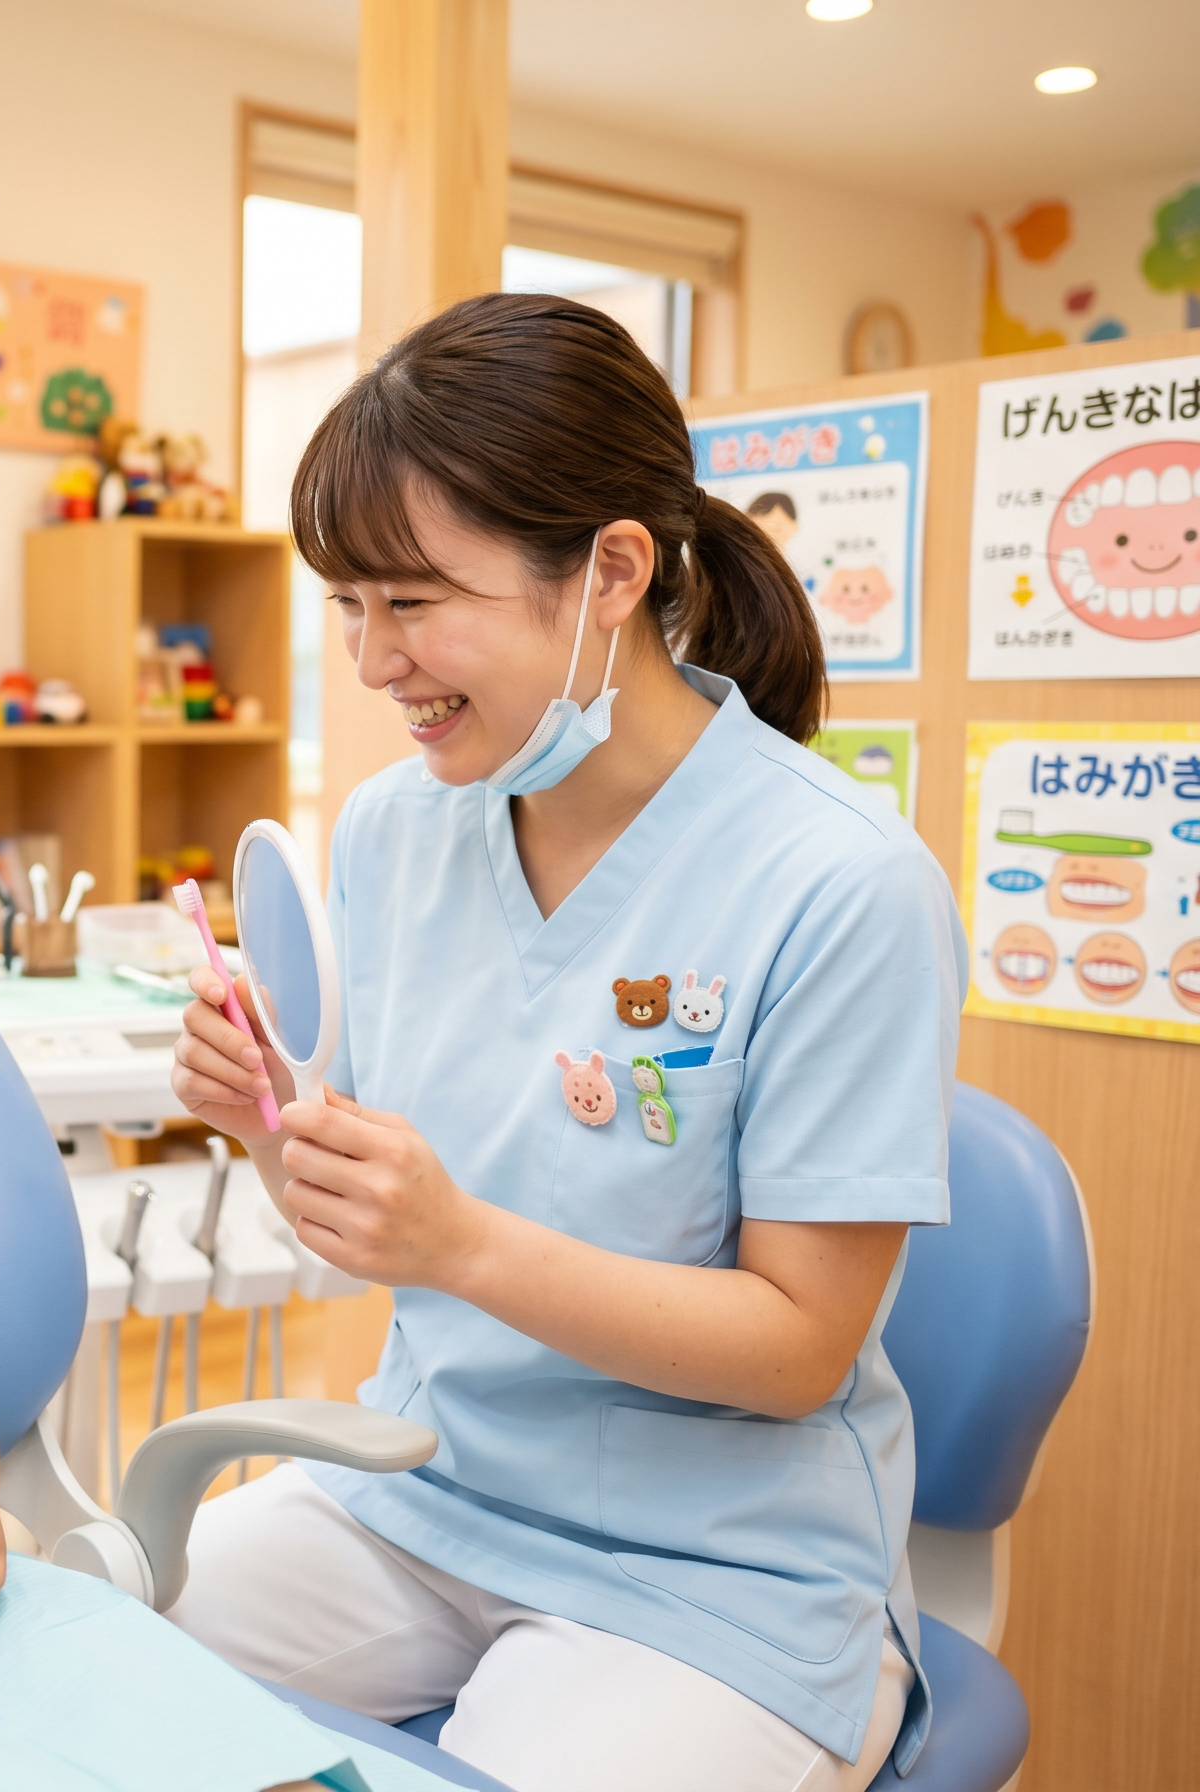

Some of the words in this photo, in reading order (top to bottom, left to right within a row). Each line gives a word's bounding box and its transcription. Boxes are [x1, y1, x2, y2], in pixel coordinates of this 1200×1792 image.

[1003, 378, 1200, 438] げんきなは
[711, 422, 842, 474] はみがき
[1031, 749, 1200, 800] はみがき
